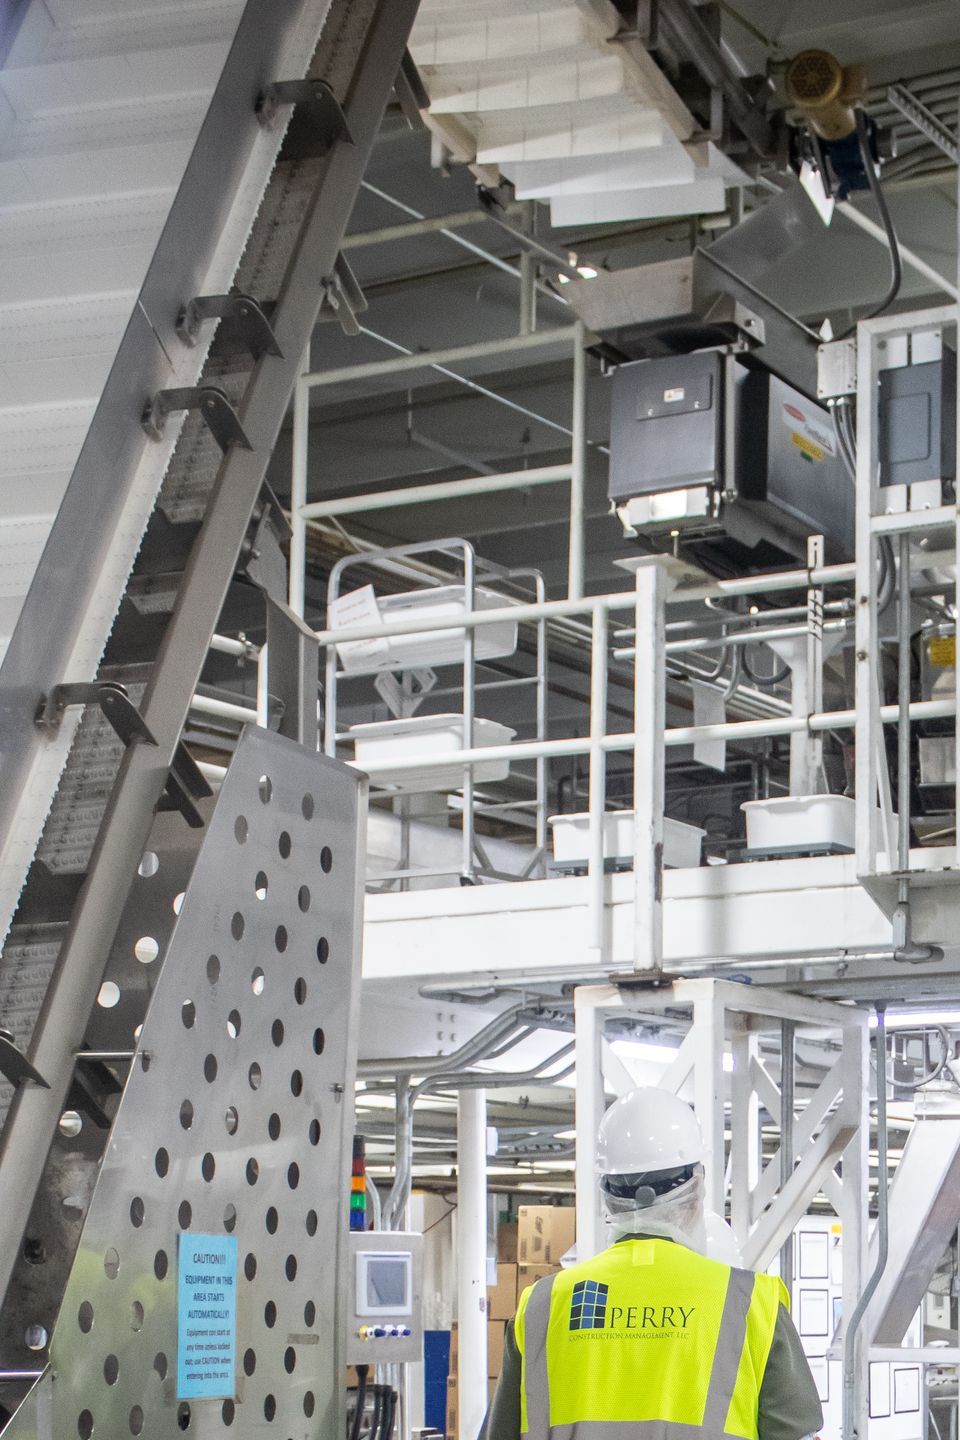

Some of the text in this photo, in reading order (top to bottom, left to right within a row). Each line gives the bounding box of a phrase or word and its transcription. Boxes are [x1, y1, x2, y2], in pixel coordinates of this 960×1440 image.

[193, 1253, 226, 1265] CAUTION!!!
[185, 1275, 233, 1286] EQUIPMENT IN THIS
[193, 1292, 225, 1302] AREA STARTS
[609, 1306, 696, 1328] PERRY
[568, 1333, 624, 1342] CONSTRUCTION
